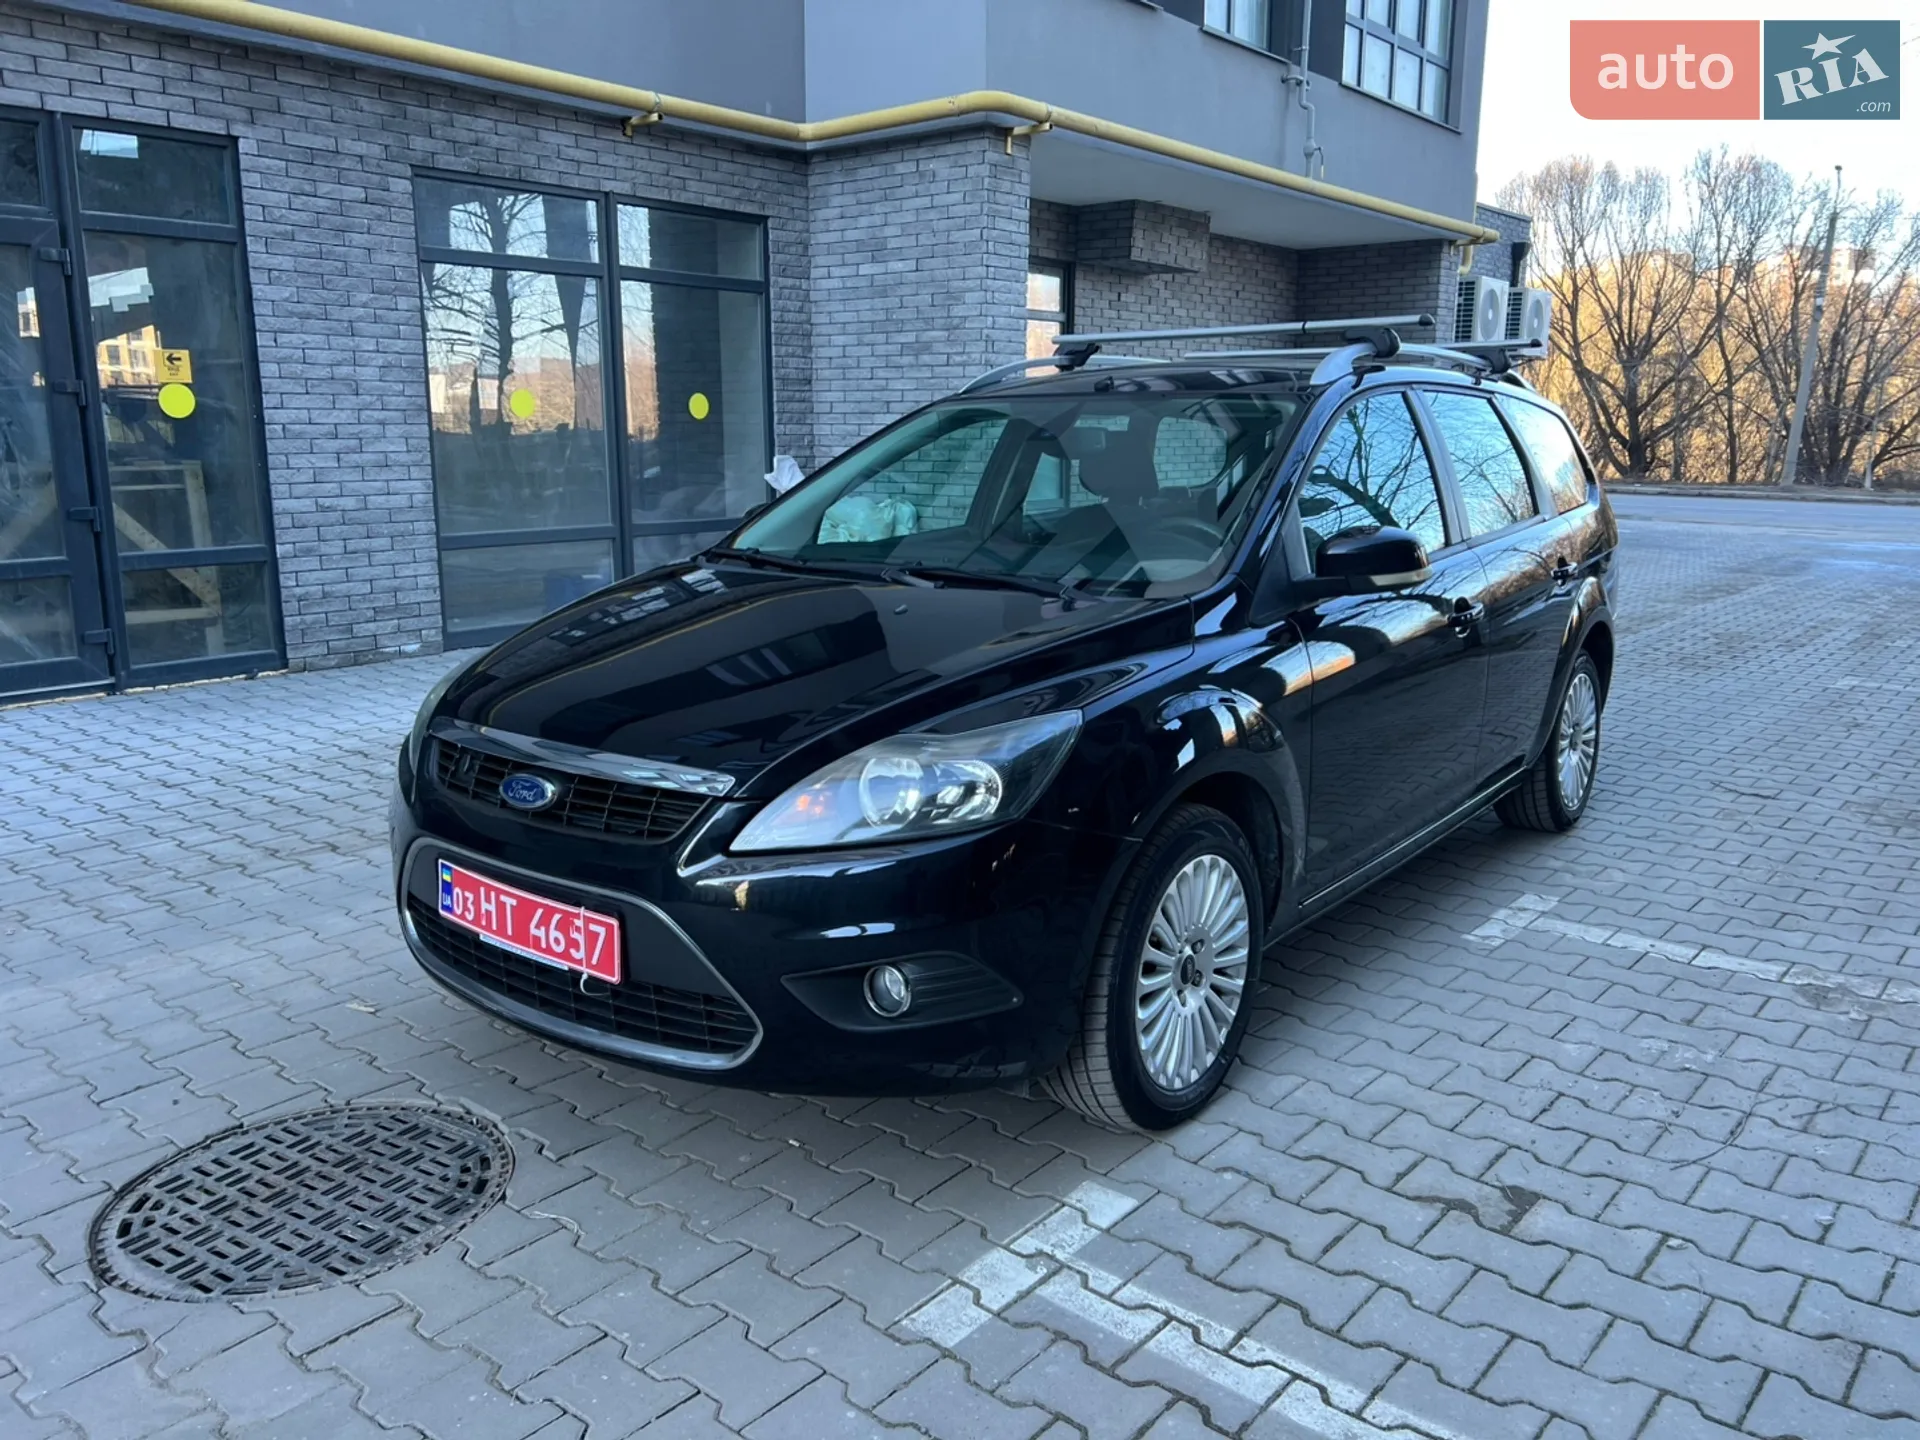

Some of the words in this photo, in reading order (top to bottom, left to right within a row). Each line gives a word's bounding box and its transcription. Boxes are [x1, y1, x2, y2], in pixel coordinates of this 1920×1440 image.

[508, 780, 537, 801] Ford
[453, 887, 475, 921] 03
[480, 887, 517, 936] HT
[530, 908, 606, 965] 4657
